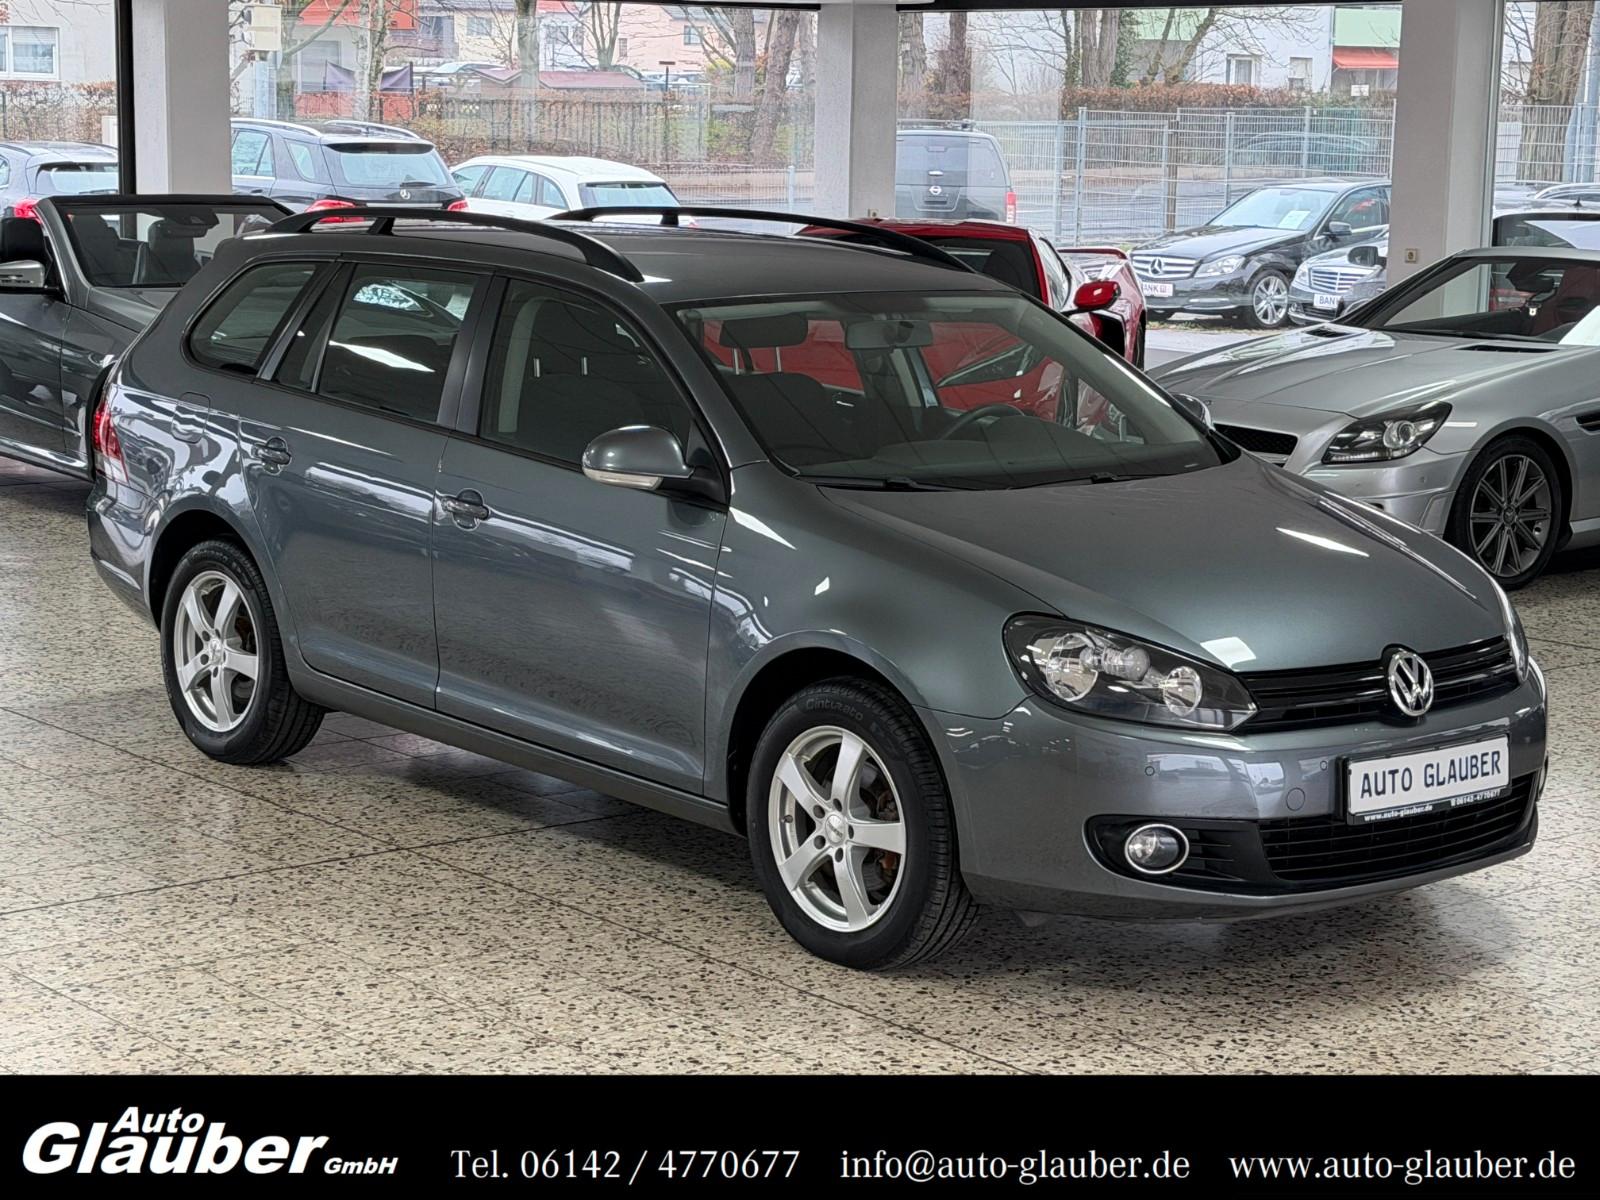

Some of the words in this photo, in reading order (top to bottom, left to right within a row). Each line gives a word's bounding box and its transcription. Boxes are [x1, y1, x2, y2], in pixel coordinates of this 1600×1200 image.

[1143, 284, 1159, 293] ANK
[1360, 767, 1413, 799] AUTO
[1423, 750, 1501, 788] GLAUBER
[1364, 803, 1433, 822] www.auto-glauber.de
